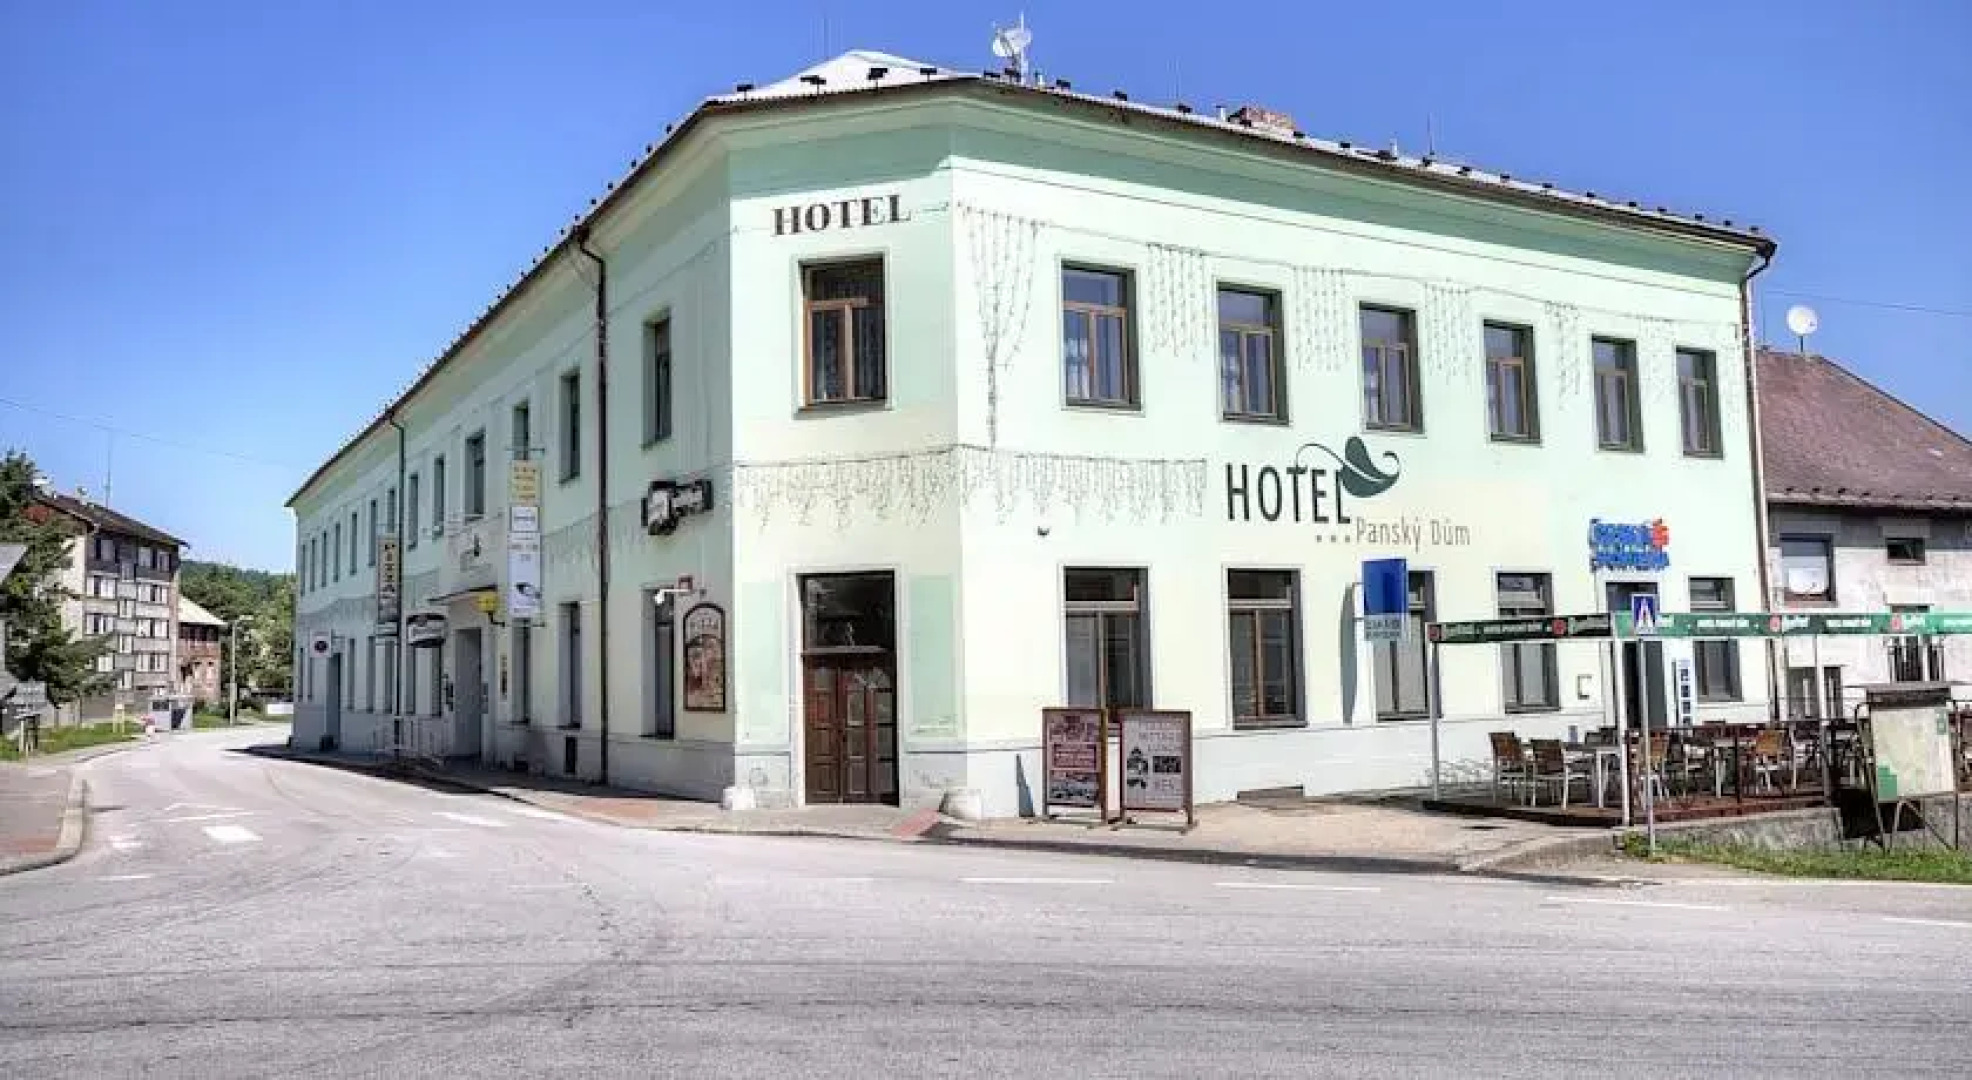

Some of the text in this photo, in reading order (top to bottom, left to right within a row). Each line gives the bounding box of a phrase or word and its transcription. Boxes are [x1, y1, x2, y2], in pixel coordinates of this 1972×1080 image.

[772, 194, 911, 235] HOTEL
[1227, 463, 1351, 523] HOTEL
[1356, 516, 1470, 552] Panský Dům
